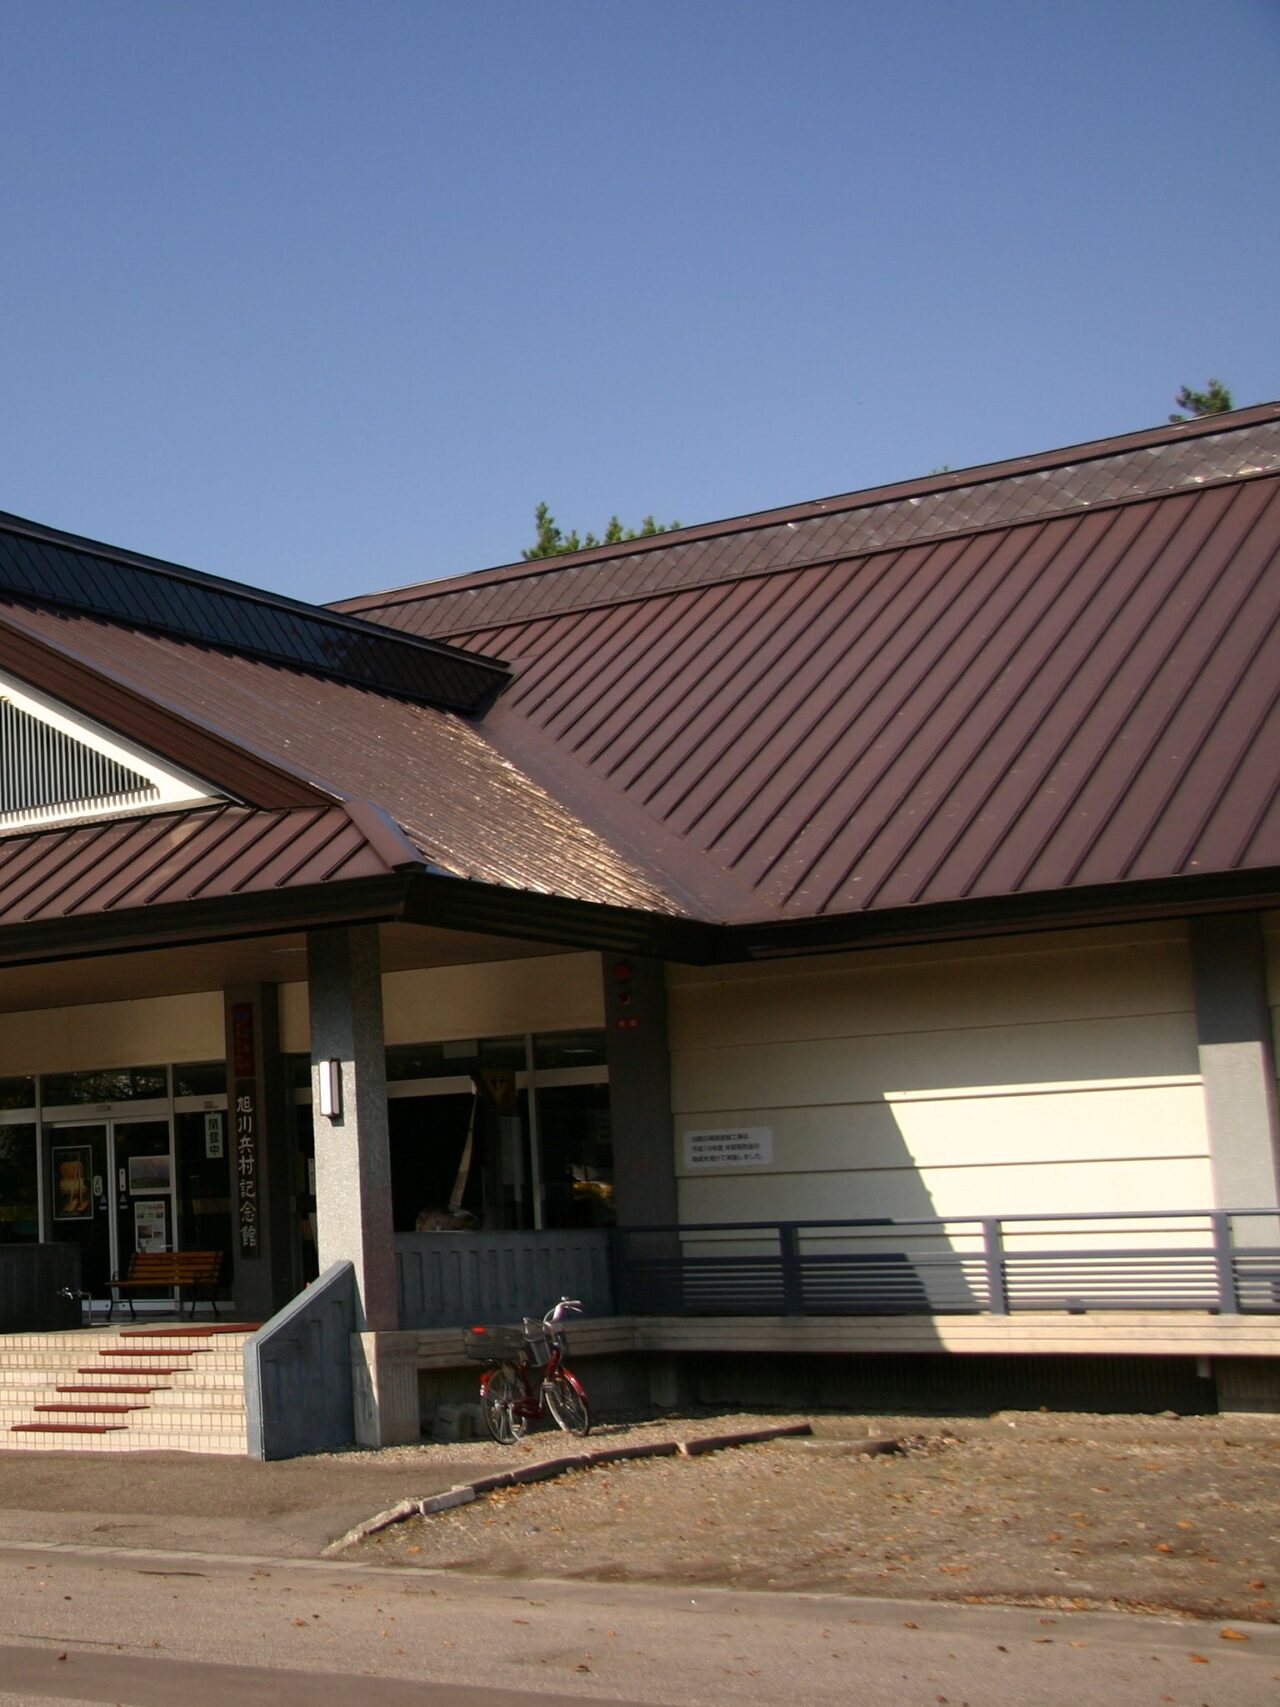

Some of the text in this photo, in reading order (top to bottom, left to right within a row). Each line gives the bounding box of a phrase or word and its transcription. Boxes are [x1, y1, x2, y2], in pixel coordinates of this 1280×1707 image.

[236, 1096, 257, 1247] 旭川兵村記念館
